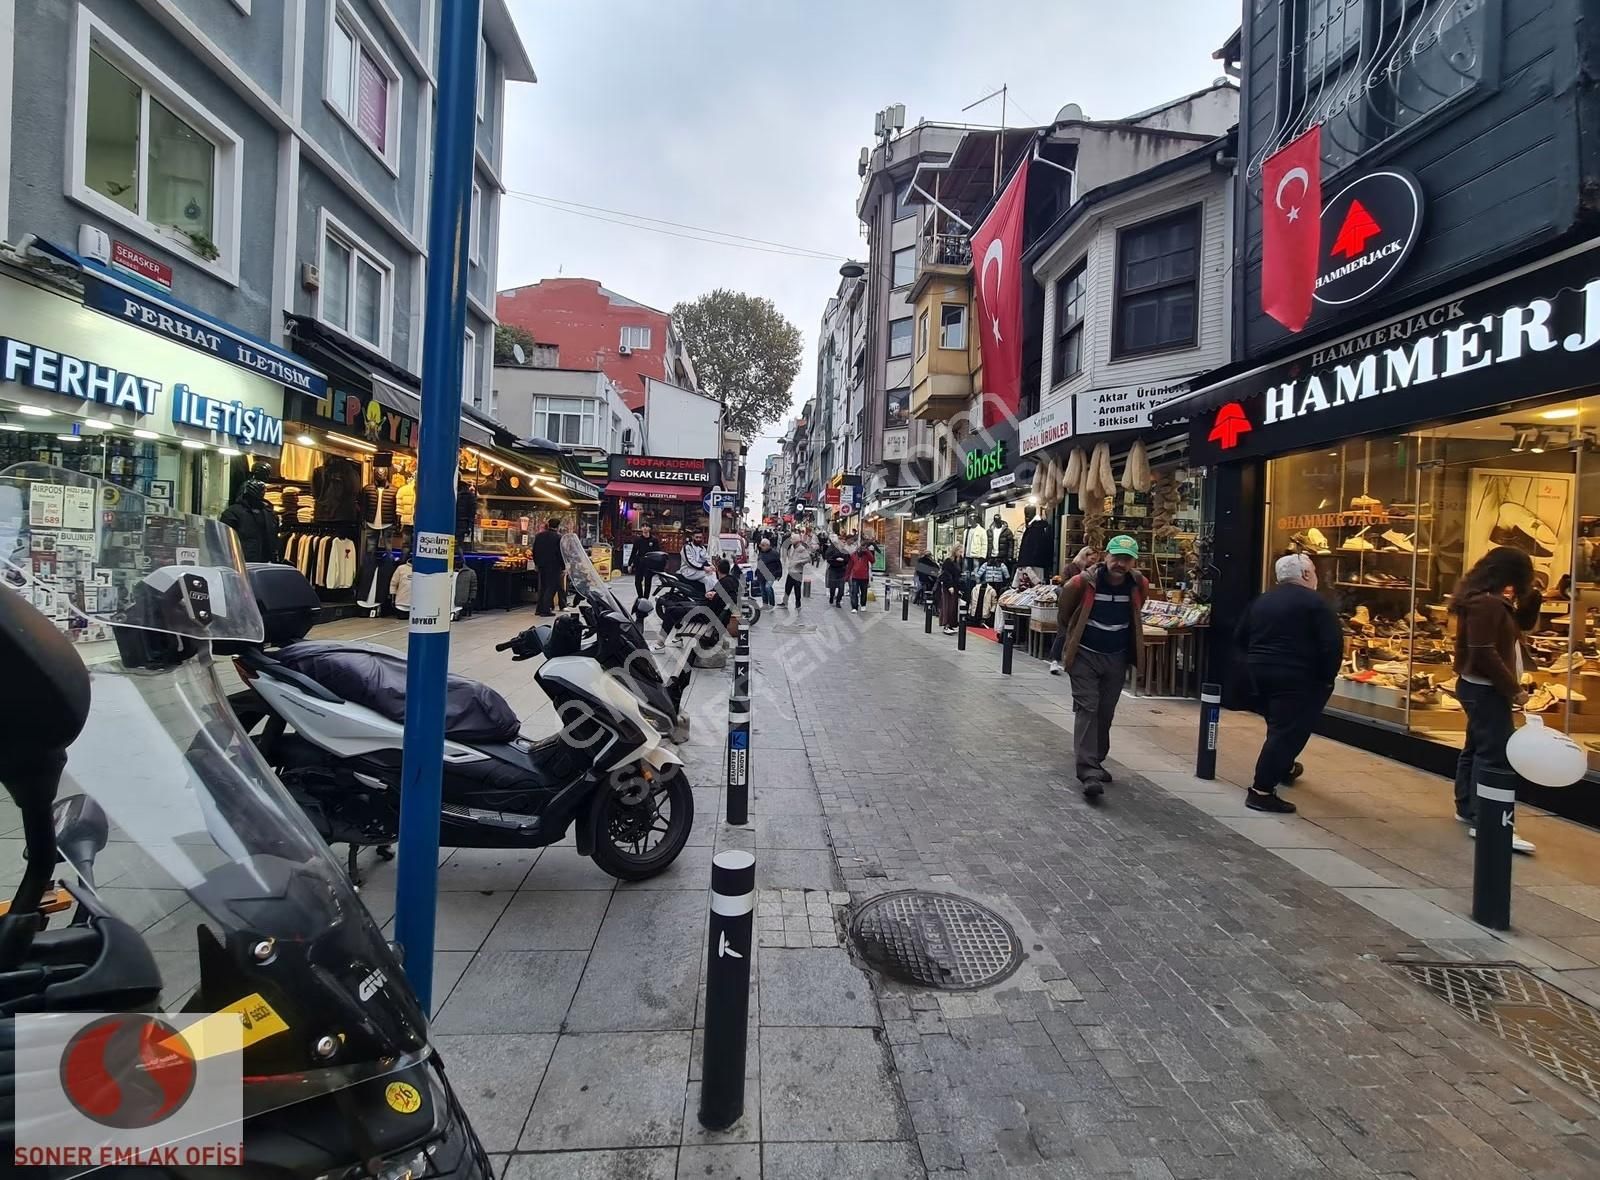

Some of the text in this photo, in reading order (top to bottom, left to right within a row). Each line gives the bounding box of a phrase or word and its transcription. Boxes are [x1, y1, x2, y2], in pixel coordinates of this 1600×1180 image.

[117, 246, 160, 273] SERASKER
[1314, 239, 1402, 289] HAMMERJACK
[124, 298, 311, 389] FERHAT İLETİŞİM
[1312, 299, 1465, 368] HAMMERJACK
[5, 338, 283, 445] FERHAT İLETİŞİM
[1099, 392, 1128, 404] Aktar
[1099, 401, 1146, 415] Aromatik
[1099, 414, 1138, 427] Bitkisel
[1023, 421, 1069, 453] DOĞAL ÜRÜNLER
[966, 440, 1003, 480] Ghost
[33, 485, 63, 495] AIRPODS
[620, 469, 710, 482] SOKAK LEZZETLERİ
